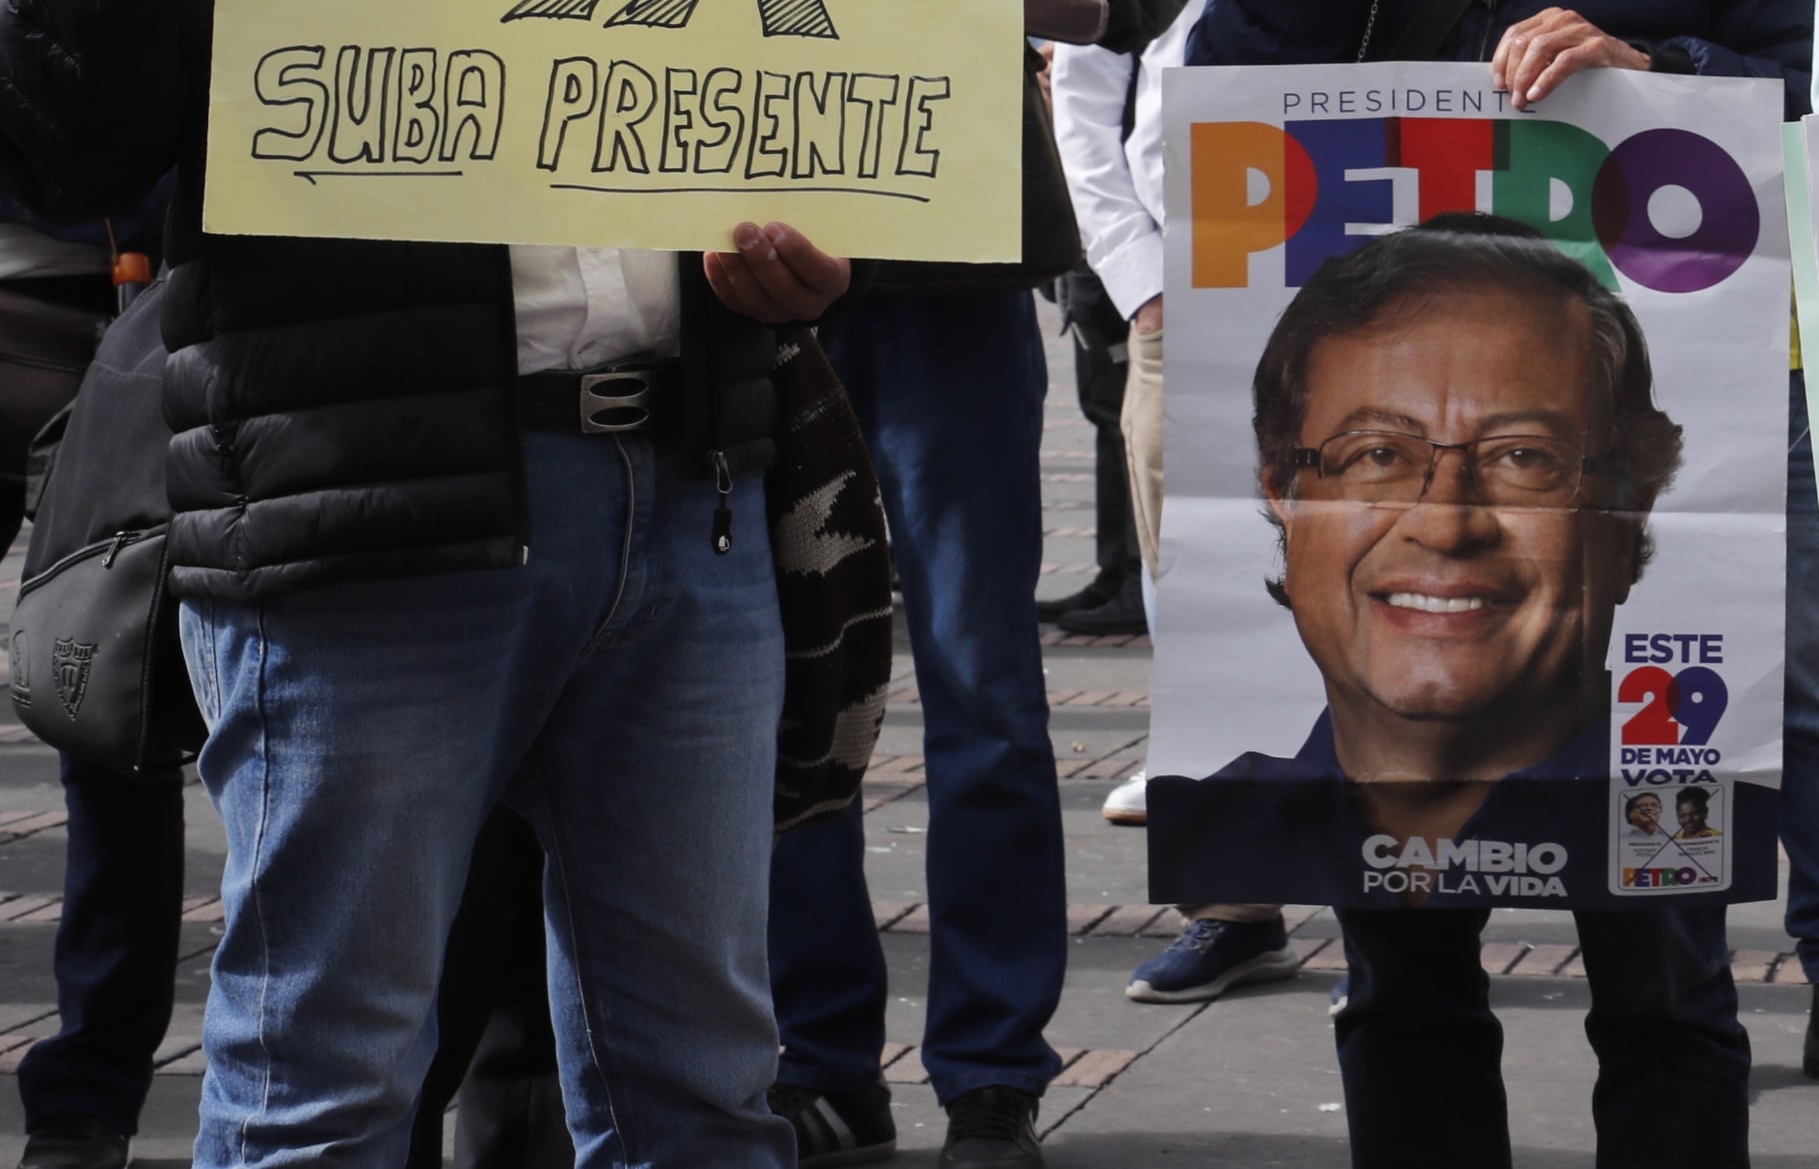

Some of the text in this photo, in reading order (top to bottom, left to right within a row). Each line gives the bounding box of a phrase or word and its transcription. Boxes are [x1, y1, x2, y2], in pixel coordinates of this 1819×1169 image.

[251, 45, 952, 181] SUBA PRESENTE
[1284, 89, 1536, 114] PRESIDENT
[1190, 116, 1761, 294] PETRO
[1625, 633, 1724, 664] ESTE
[1618, 665, 1729, 746] 29
[1621, 748, 1721, 766] DE MAYO
[1621, 768, 1717, 787] VOTA
[1361, 834, 1568, 875] CAMBIO
[1363, 871, 1569, 897] POR LA VIDA
[1622, 866, 1697, 887] PETRO
